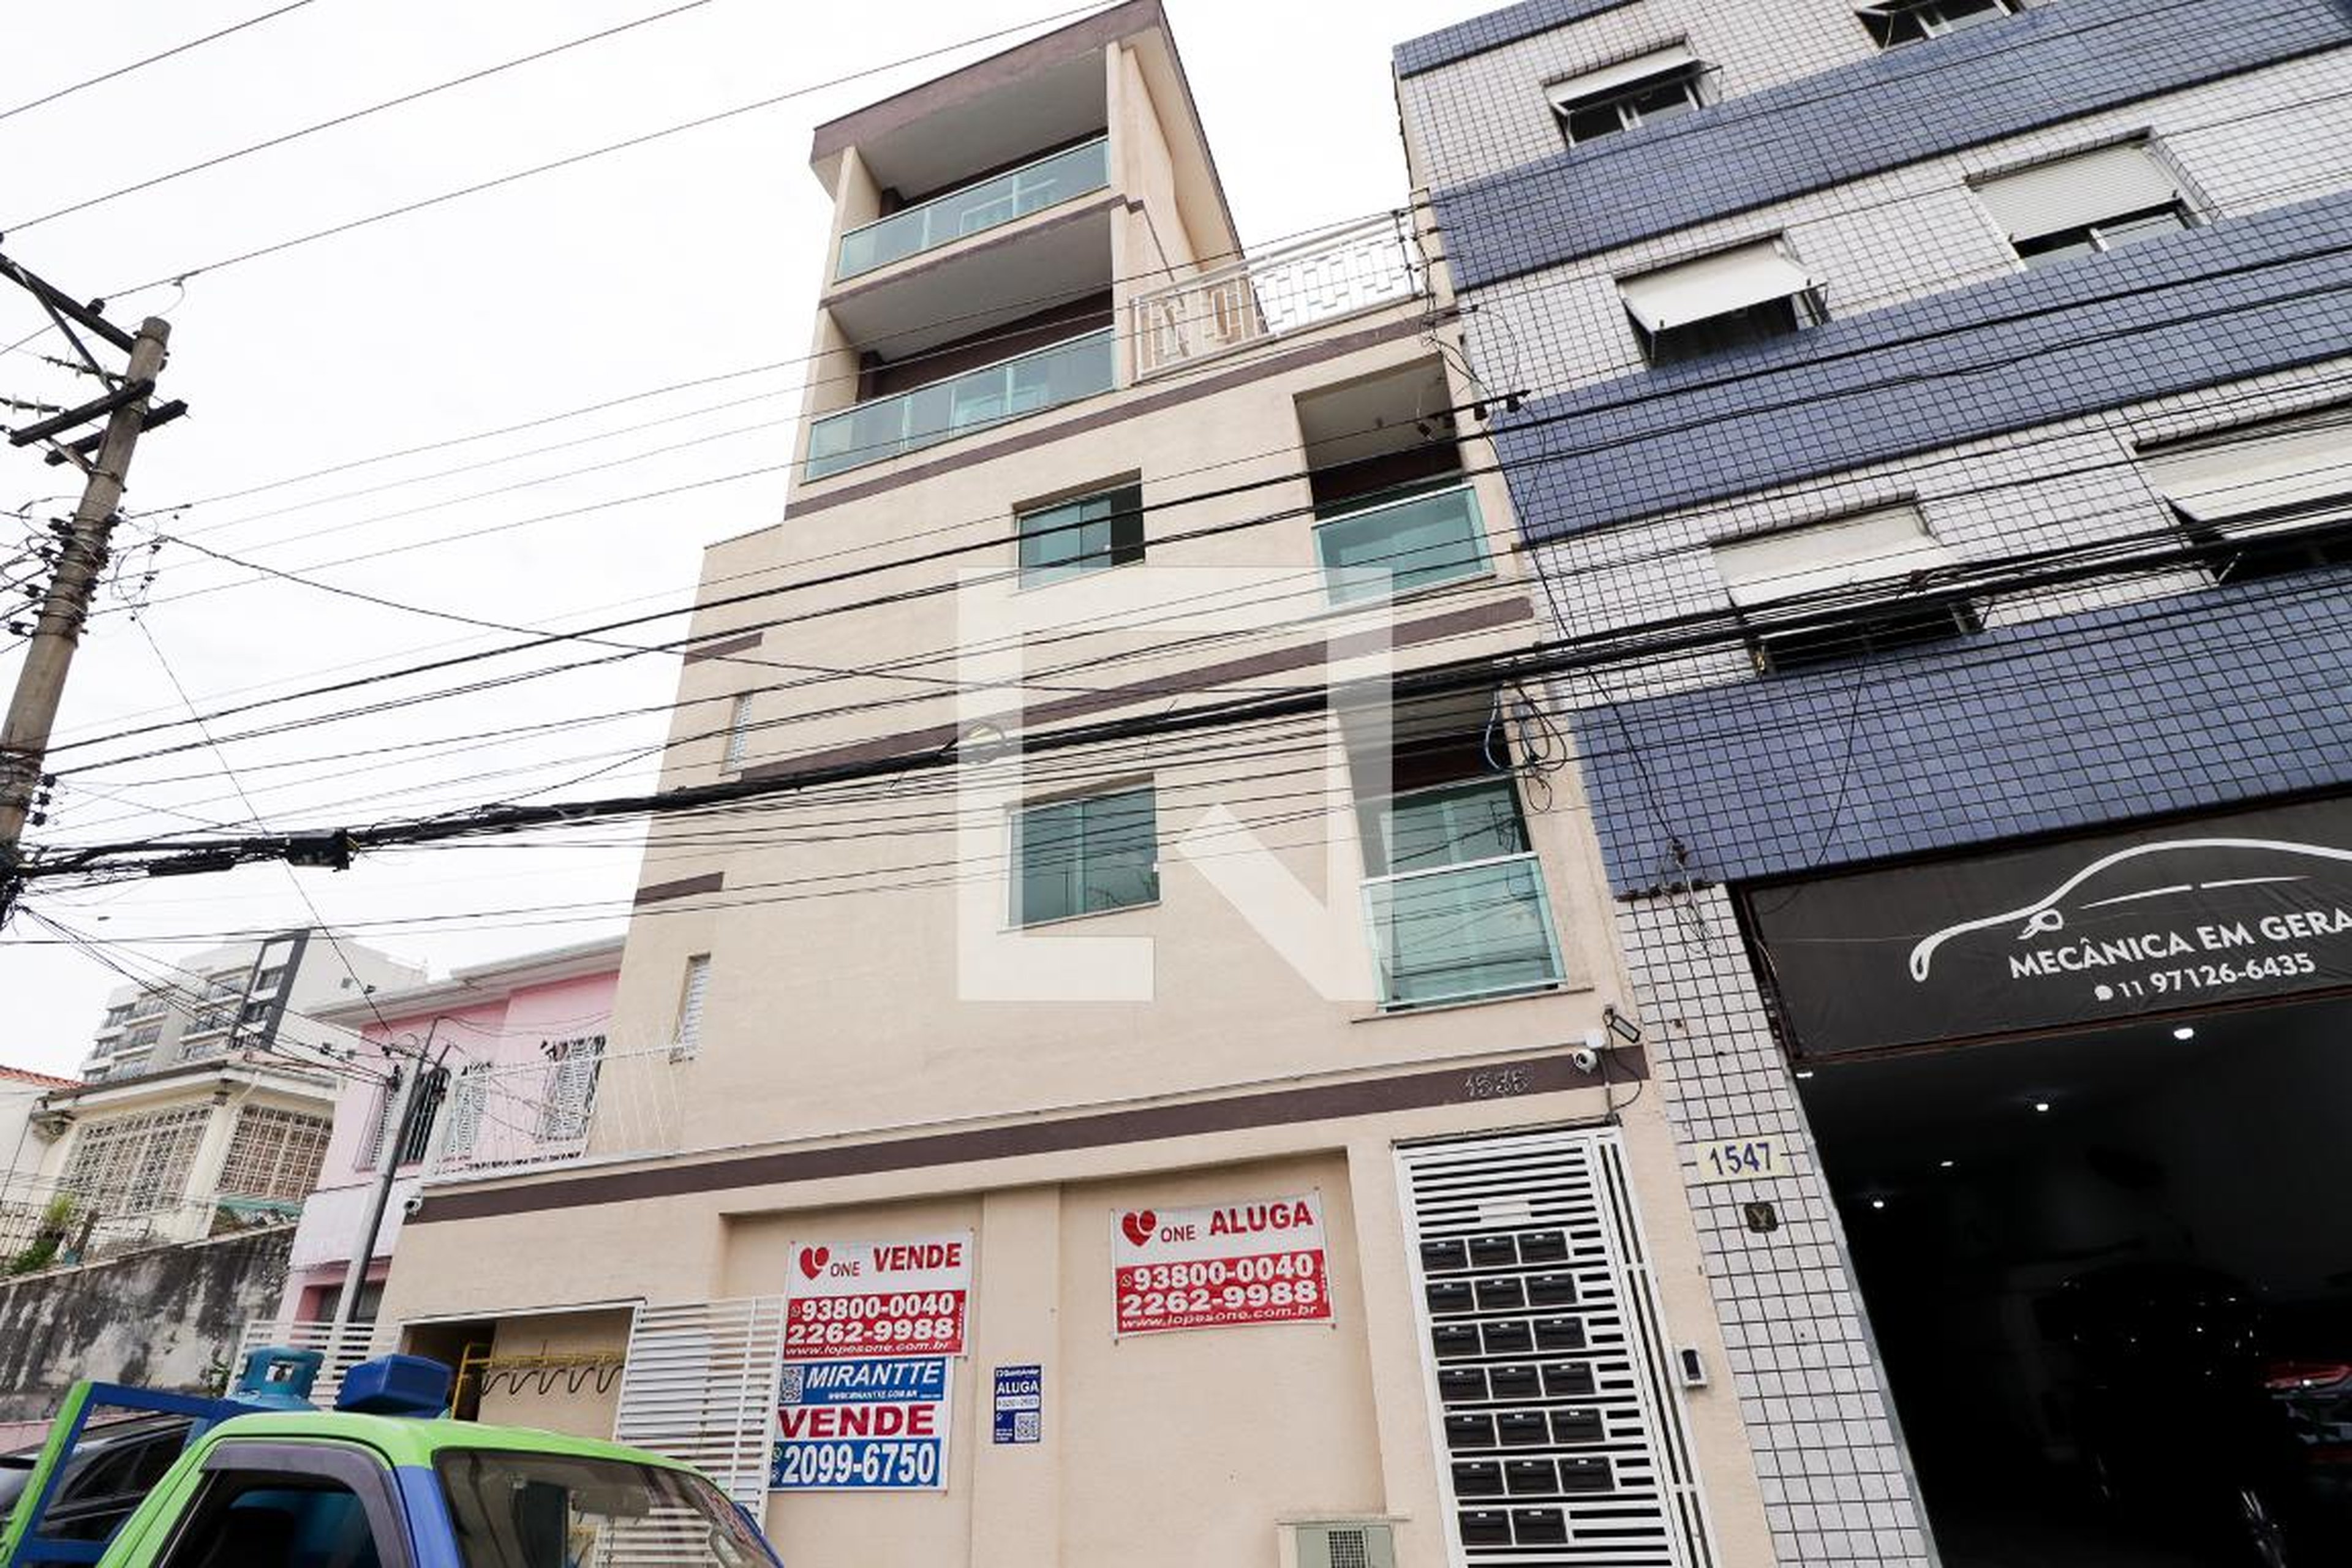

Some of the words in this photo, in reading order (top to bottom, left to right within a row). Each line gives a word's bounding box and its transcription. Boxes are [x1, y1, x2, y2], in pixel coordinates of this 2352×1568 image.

[2008, 931, 2195, 979] MECÂNICA
[2196, 921, 2256, 949] EM
[2118, 981, 2144, 997] 11
[2149, 952, 2315, 993] 97126-6435
[1710, 1143, 1771, 1175] 1547
[1161, 1225, 1196, 1242] ONE
[1209, 1201, 1313, 1236] ALUGA
[831, 1262, 861, 1277] ONE
[873, 1243, 962, 1272] VENDE
[1134, 1254, 1313, 1291] 93800-0040
[802, 1293, 954, 1321] 93800-0040
[1122, 1280, 1317, 1317] 2262-9988
[787, 1317, 954, 1344] 2262-9988
[1121, 1305, 1317, 1329] www.lopesone.com.br
[806, 1362, 942, 1389] MIRANTTE
[997, 1381, 1039, 1394] ALUGA
[778, 1405, 935, 1438] VENDE
[782, 1443, 935, 1484] 2099-6750
